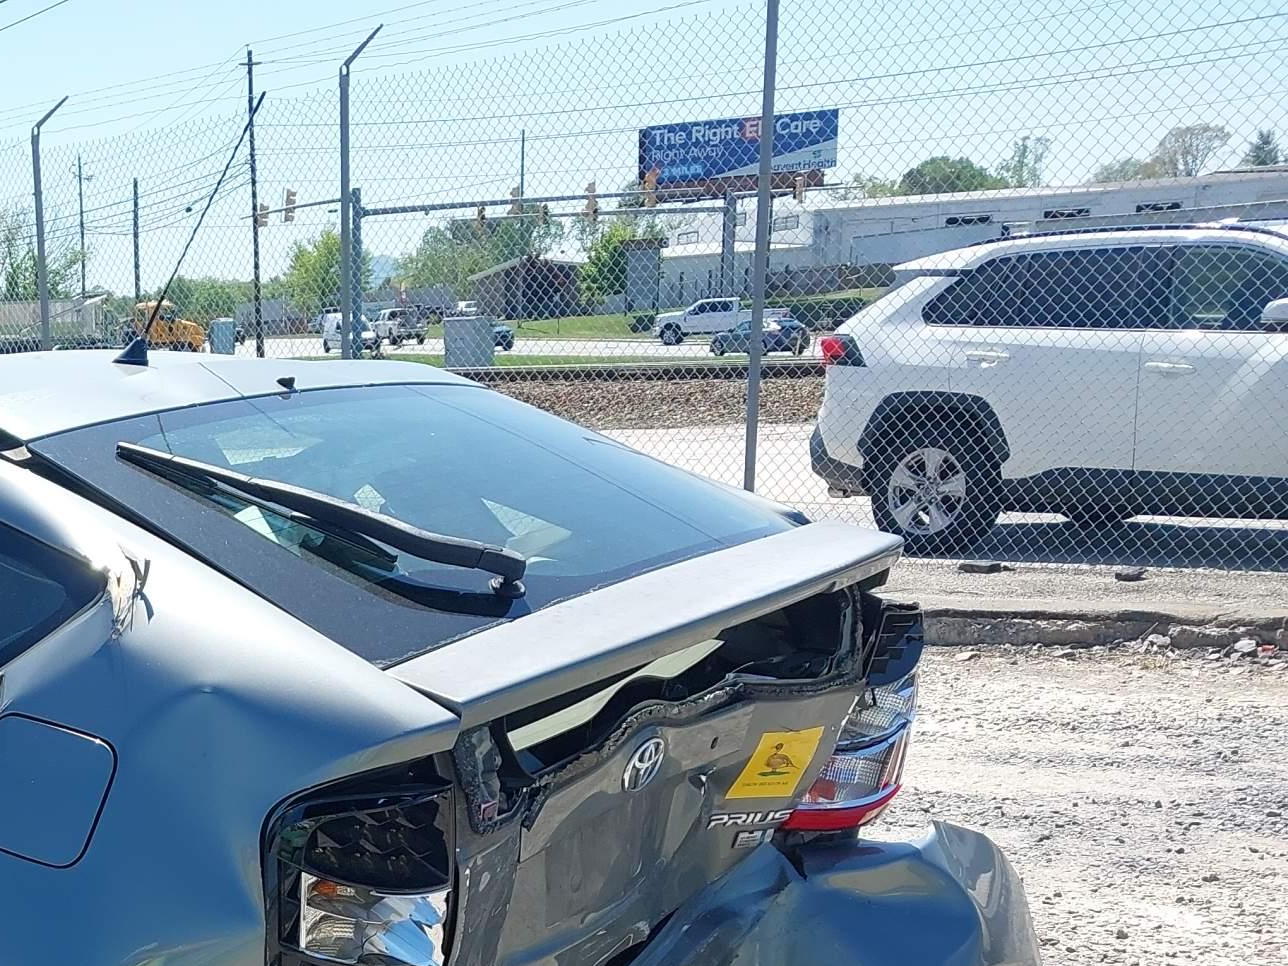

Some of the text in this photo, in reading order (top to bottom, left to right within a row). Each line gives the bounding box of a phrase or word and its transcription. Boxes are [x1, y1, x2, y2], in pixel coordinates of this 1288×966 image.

[652, 127, 686, 146] The
[691, 123, 741, 144] Right
[775, 118, 821, 134] Care
[651, 146, 723, 162] Right Away
[773, 158, 837, 171] dventHealth
[706, 808, 795, 830] PRIUS
